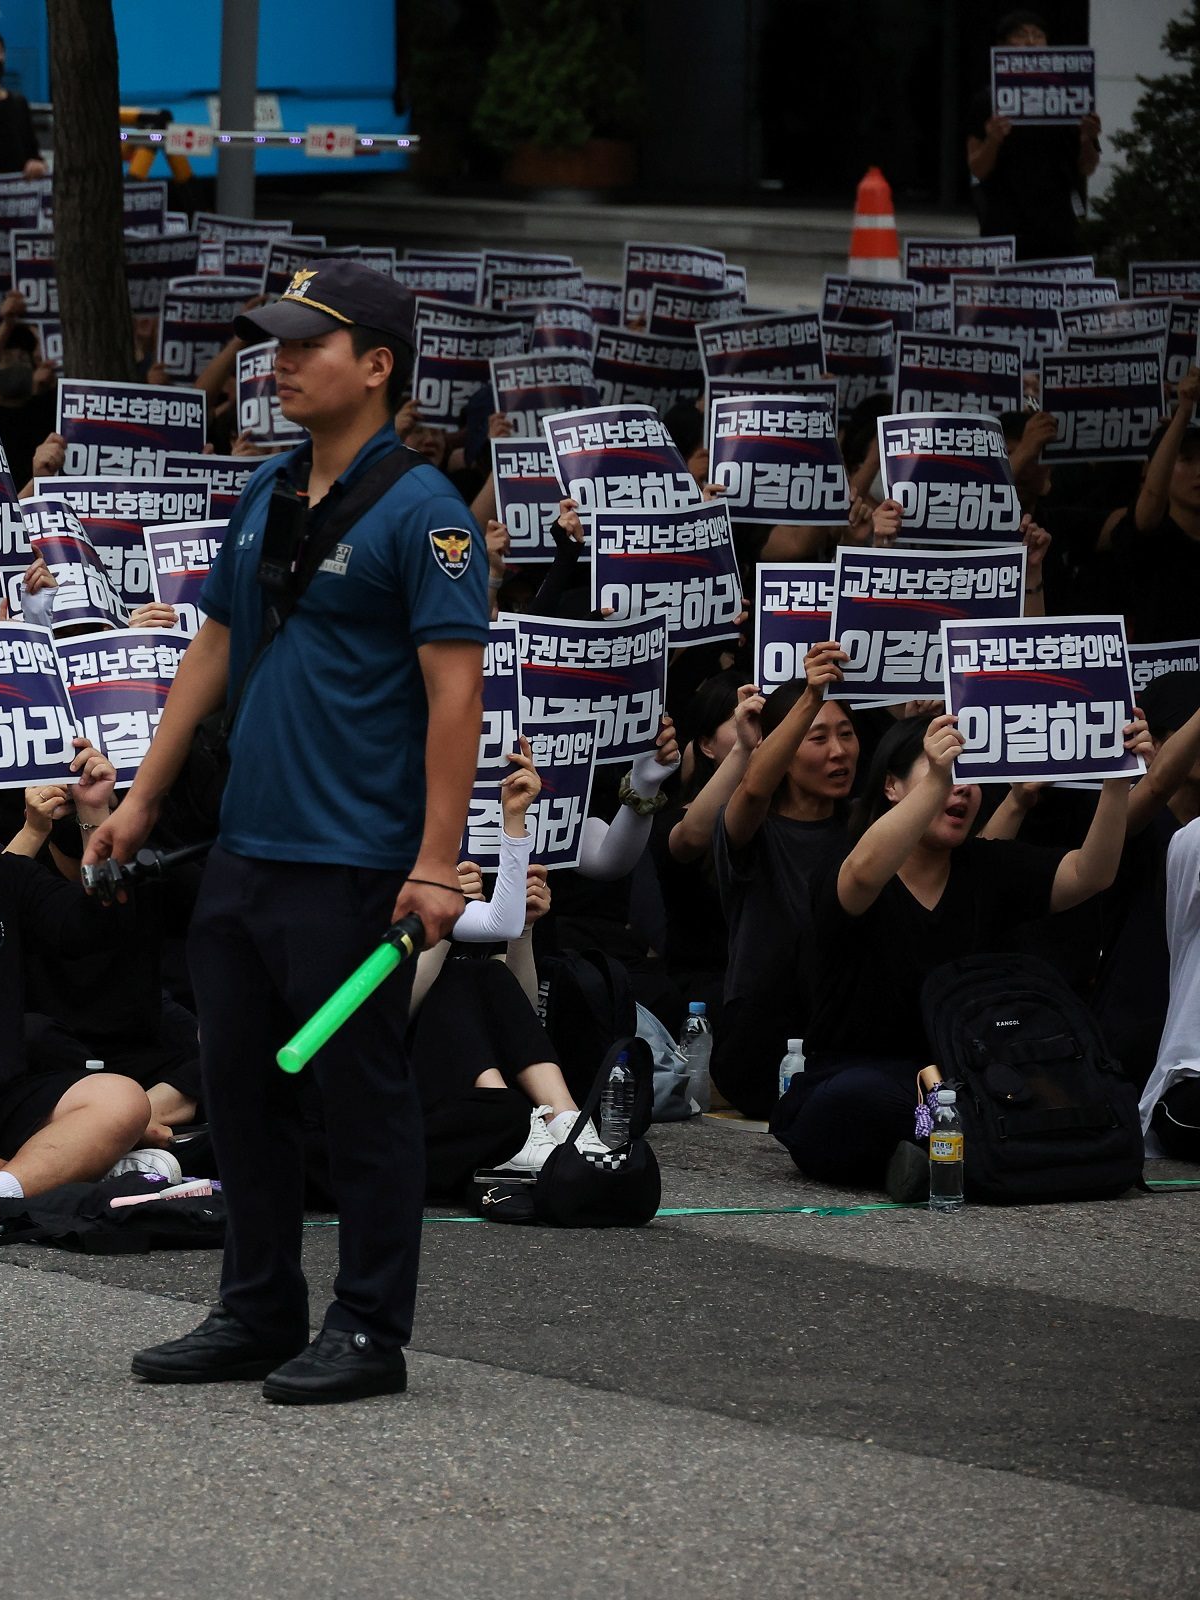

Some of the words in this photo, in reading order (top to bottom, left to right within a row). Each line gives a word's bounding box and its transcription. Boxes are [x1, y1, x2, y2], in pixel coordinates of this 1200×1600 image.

[997, 86, 1095, 116] 의결하라
[704, 321, 820, 357] 교권보호합의안
[1064, 308, 1168, 335] 교권보호합의
[596, 336, 699, 371] 교권보호합의
[901, 343, 1020, 376] 교권보호합의안
[1045, 361, 1158, 390] 교권보호합의안
[62, 393, 202, 428] 교권보호합의안
[553, 418, 677, 456] 교권보호합
[598, 518, 728, 555] 교권보호합의안
[841, 565, 1020, 600] 교권보호합의안
[600, 572, 742, 631] 의결하라
[61, 644, 190, 688] 권보호합
[836, 629, 943, 683] 의결
[950, 634, 1123, 674] 교권보호합의안
[957, 701, 1132, 763] 의결하라
[996, 1019, 1020, 1027] KANGOL
